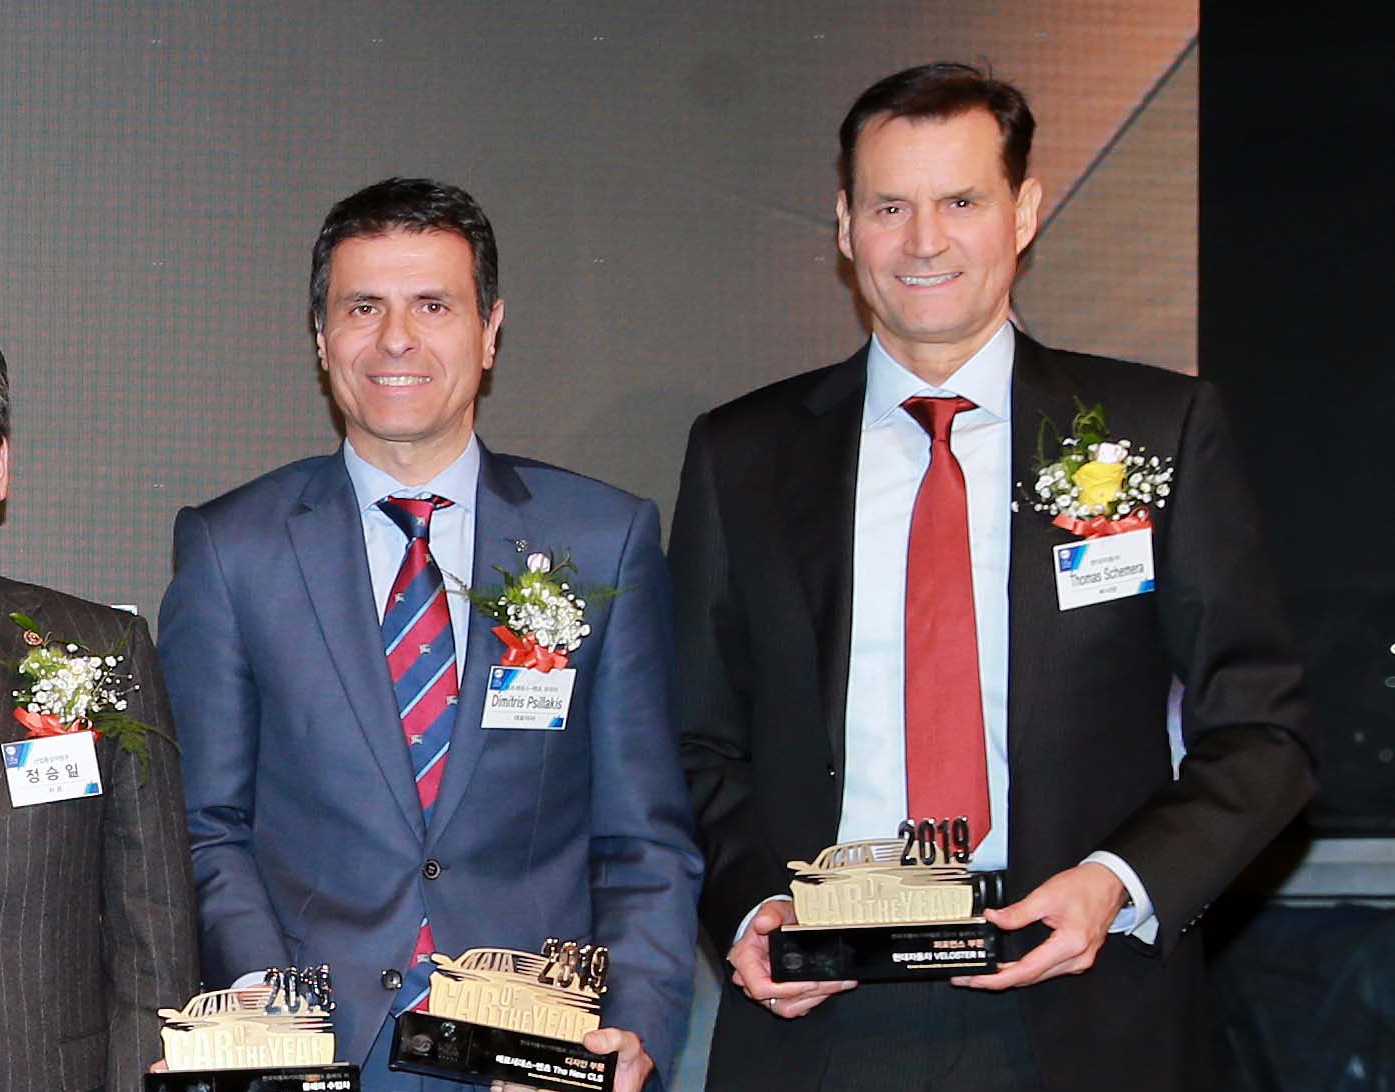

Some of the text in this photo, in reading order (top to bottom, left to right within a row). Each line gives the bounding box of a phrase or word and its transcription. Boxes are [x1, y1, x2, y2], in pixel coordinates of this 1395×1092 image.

[491, 694, 524, 708] Dimitris
[898, 816, 973, 866] 2019
[803, 883, 865, 924] CAR
[898, 887, 971, 920] YEAR
[538, 936, 608, 993] 2019
[437, 983, 497, 1024] CAR
[498, 1004, 533, 1028] THE
[531, 1005, 590, 1042] YEAR
[170, 1030, 232, 1070] CAR
[234, 1046, 267, 1068] THE
[266, 1034, 325, 1066] YEAR
[553, 1066, 568, 1075] The
